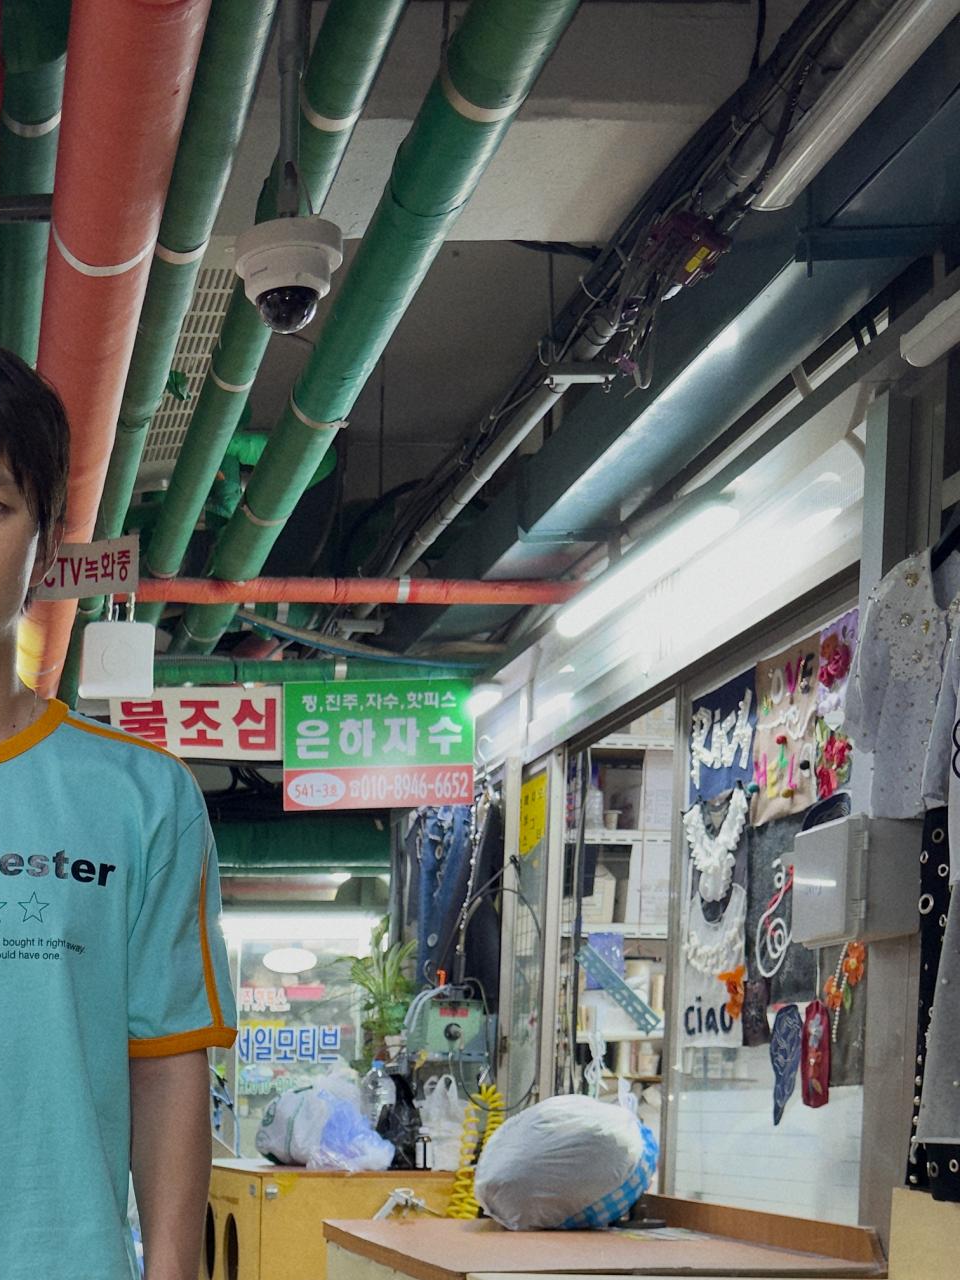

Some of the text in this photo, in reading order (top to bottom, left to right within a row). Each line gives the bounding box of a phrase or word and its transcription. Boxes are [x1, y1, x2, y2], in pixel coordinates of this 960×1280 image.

[119, 698, 277, 751] 불조심
[295, 716, 463, 760] 은하자수
[360, 772, 469, 800] 010-8946-6652
[2, 937, 35, 949] bought
[37, 938, 43, 946] it
[18, 949, 40, 960] have
